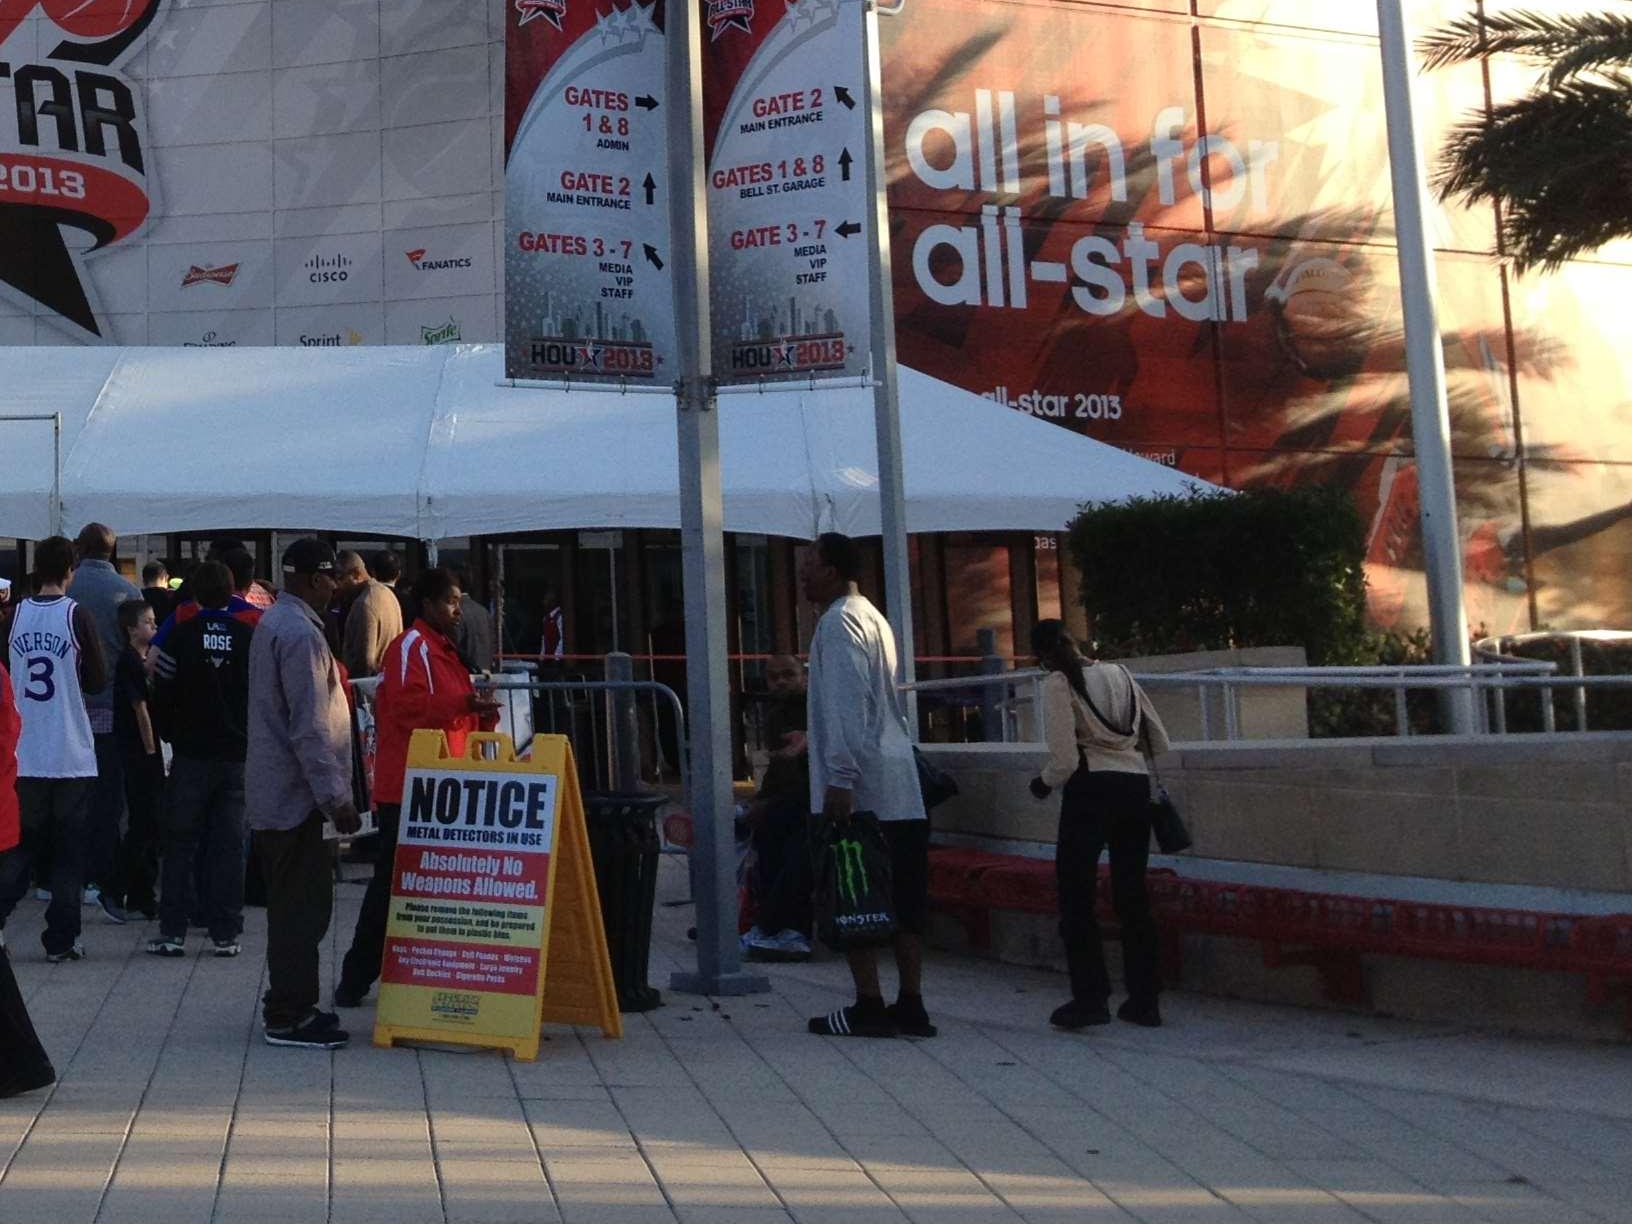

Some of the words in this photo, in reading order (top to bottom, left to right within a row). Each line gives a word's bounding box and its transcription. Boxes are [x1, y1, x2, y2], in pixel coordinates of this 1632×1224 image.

[565, 86, 629, 112] GATES
[752, 91, 804, 118] GATE
[810, 88, 823, 109] 2
[583, 113, 591, 131] 1
[599, 115, 612, 134] &
[618, 117, 629, 136] 8
[740, 121, 765, 134] MAIN
[768, 111, 823, 130] ENTRANCE
[597, 139, 630, 151] ADMIN
[906, 89, 1019, 195] all
[1043, 94, 1128, 204] in
[1149, 106, 1279, 216] for
[560, 170, 614, 195] GATE
[619, 177, 631, 196] 2
[712, 163, 773, 190] GATES
[778, 160, 786, 178] 1
[793, 157, 807, 177] &
[812, 154, 824, 174] 8
[740, 186, 764, 199] BELL
[767, 184, 780, 195] ST.
[782, 178, 825, 193] GARAGE
[547, 192, 573, 204] MAIN
[576, 195, 631, 210] ENTRANCE
[519, 231, 587, 256] GATES
[593, 238, 604, 257] 3
[621, 240, 632, 259] 7
[731, 226, 781, 250] GATE
[786, 223, 797, 243] 3
[815, 219, 826, 239] 7
[794, 244, 827, 257] MEDIA
[422, 258, 472, 270] FANATICS
[599, 262, 633, 274] MEDIA
[810, 258, 827, 269] VIP
[912, 206, 1259, 323] all-star
[616, 276, 633, 287] VIP
[796, 272, 827, 285] STAFF
[601, 288, 633, 299] STAFF
[300, 334, 341, 347] Sprint
[424, 324, 457, 346] Sprite
[531, 343, 576, 365] HOU
[603, 347, 653, 371] 2013
[732, 346, 772, 368] HOU
[795, 340, 844, 365] 2013
[1074, 393, 1122, 419] 2013
[12, 631, 72, 660] IVERSON
[203, 634, 233, 651] ROSE
[24, 656, 56, 702] 3
[408, 776, 547, 829] NOTICE
[407, 826, 440, 840] METAL
[443, 828, 505, 844] DETECTORS
[506, 831, 519, 844] IN
[520, 833, 543, 846] USE
[420, 851, 501, 877] Absolutely
[502, 856, 523, 876] No
[401, 871, 471, 895] Weapons
[473, 876, 539, 899] Allowed.
